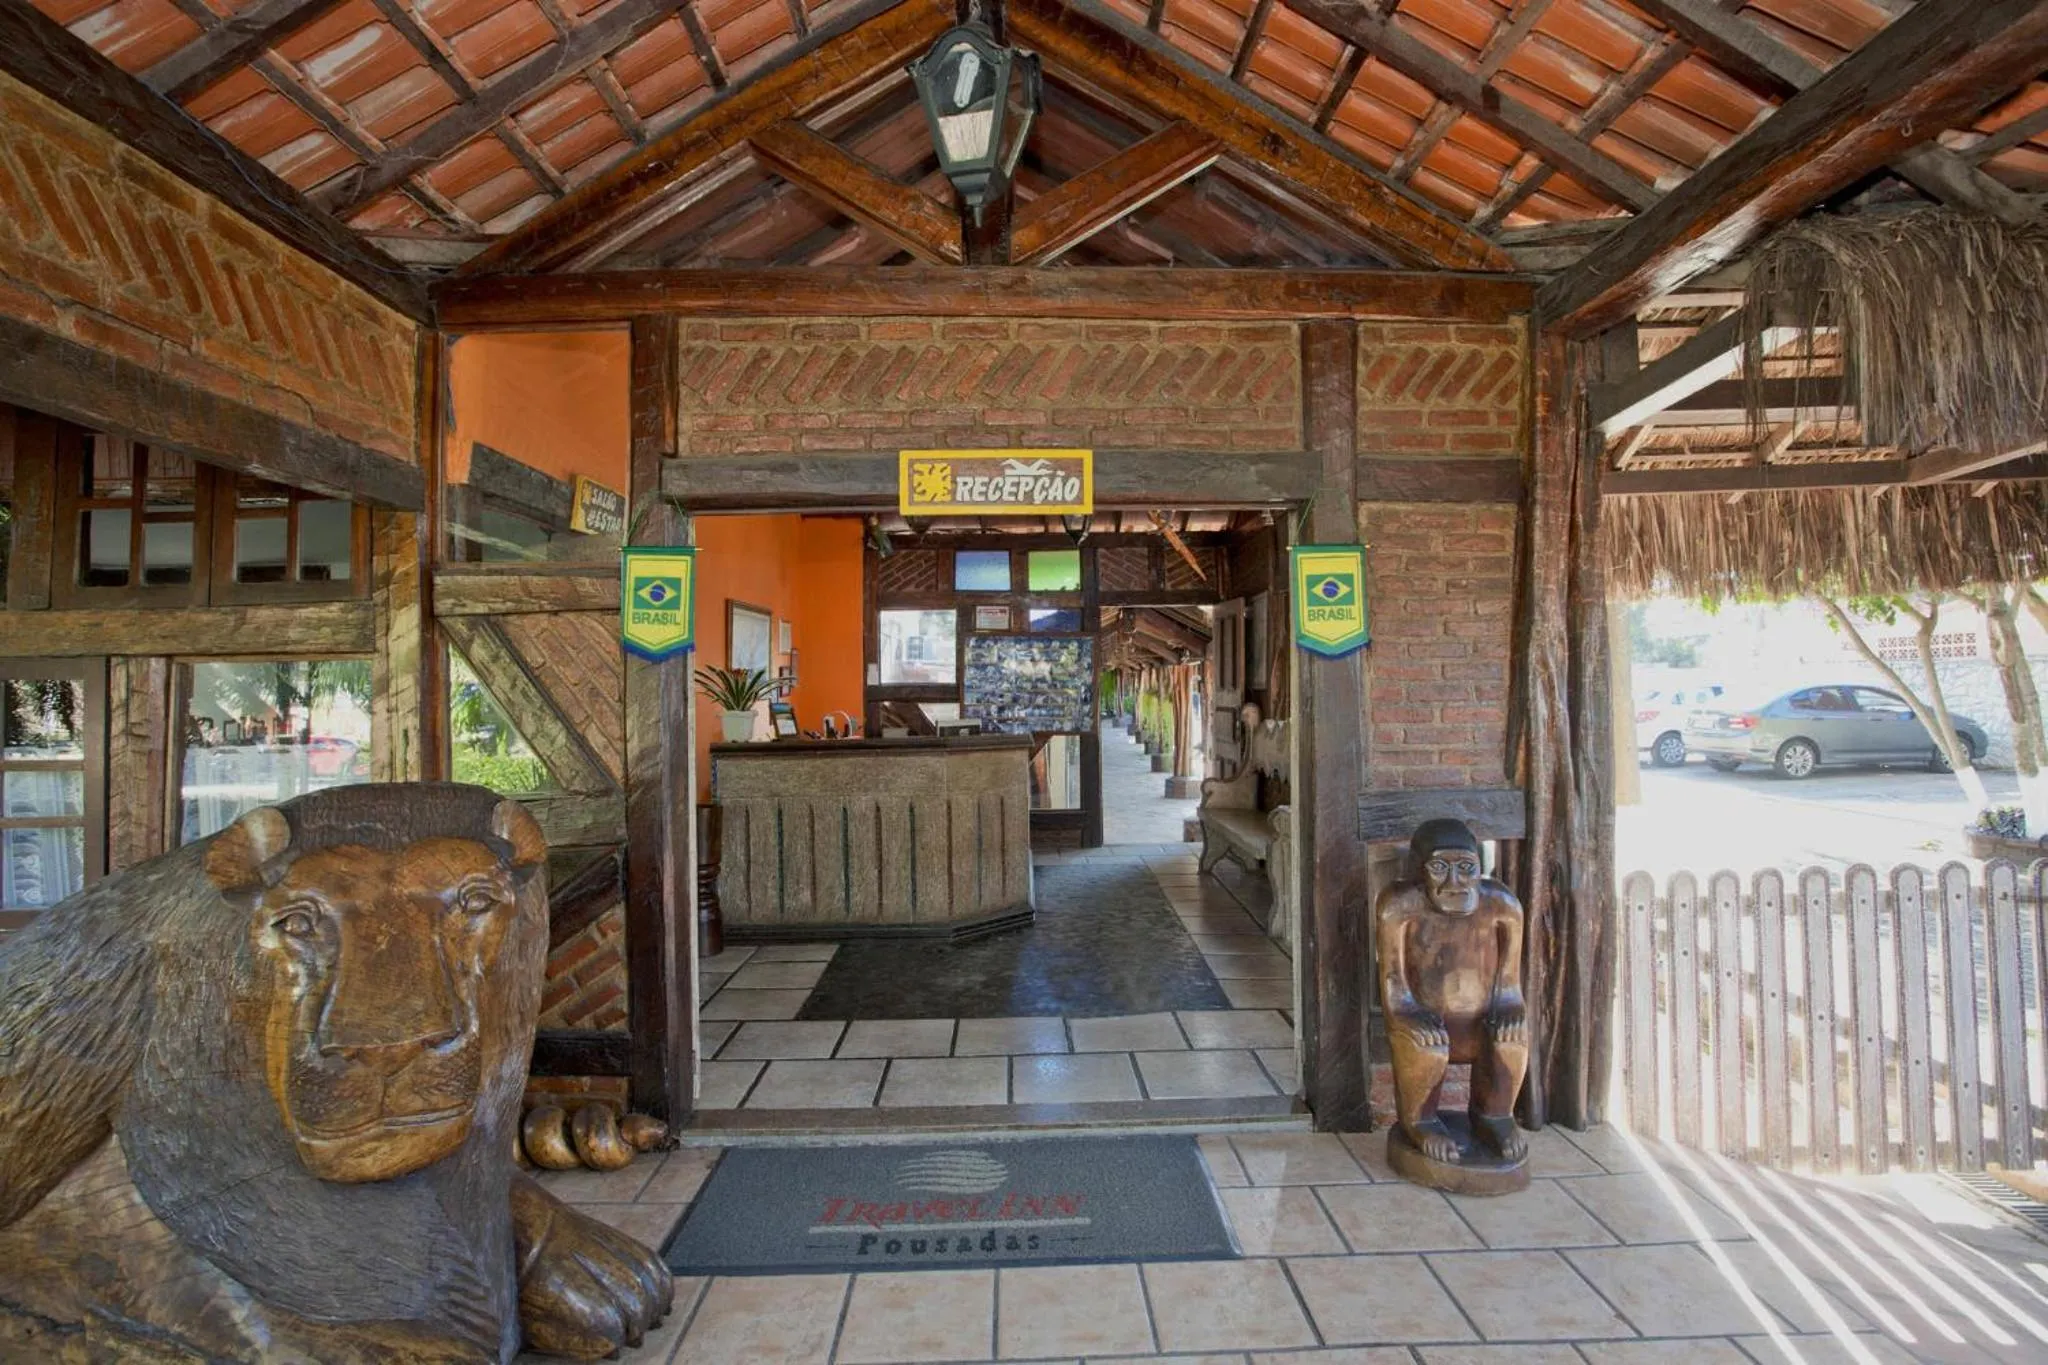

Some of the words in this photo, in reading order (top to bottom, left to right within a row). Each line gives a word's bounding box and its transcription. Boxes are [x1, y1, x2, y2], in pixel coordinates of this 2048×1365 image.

[956, 470, 1080, 504] RECEPÇÃO
[632, 611, 681, 626] BRASIL
[1307, 608, 1356, 622] BRASIL
[856, 1230, 1041, 1256] Pousadas
